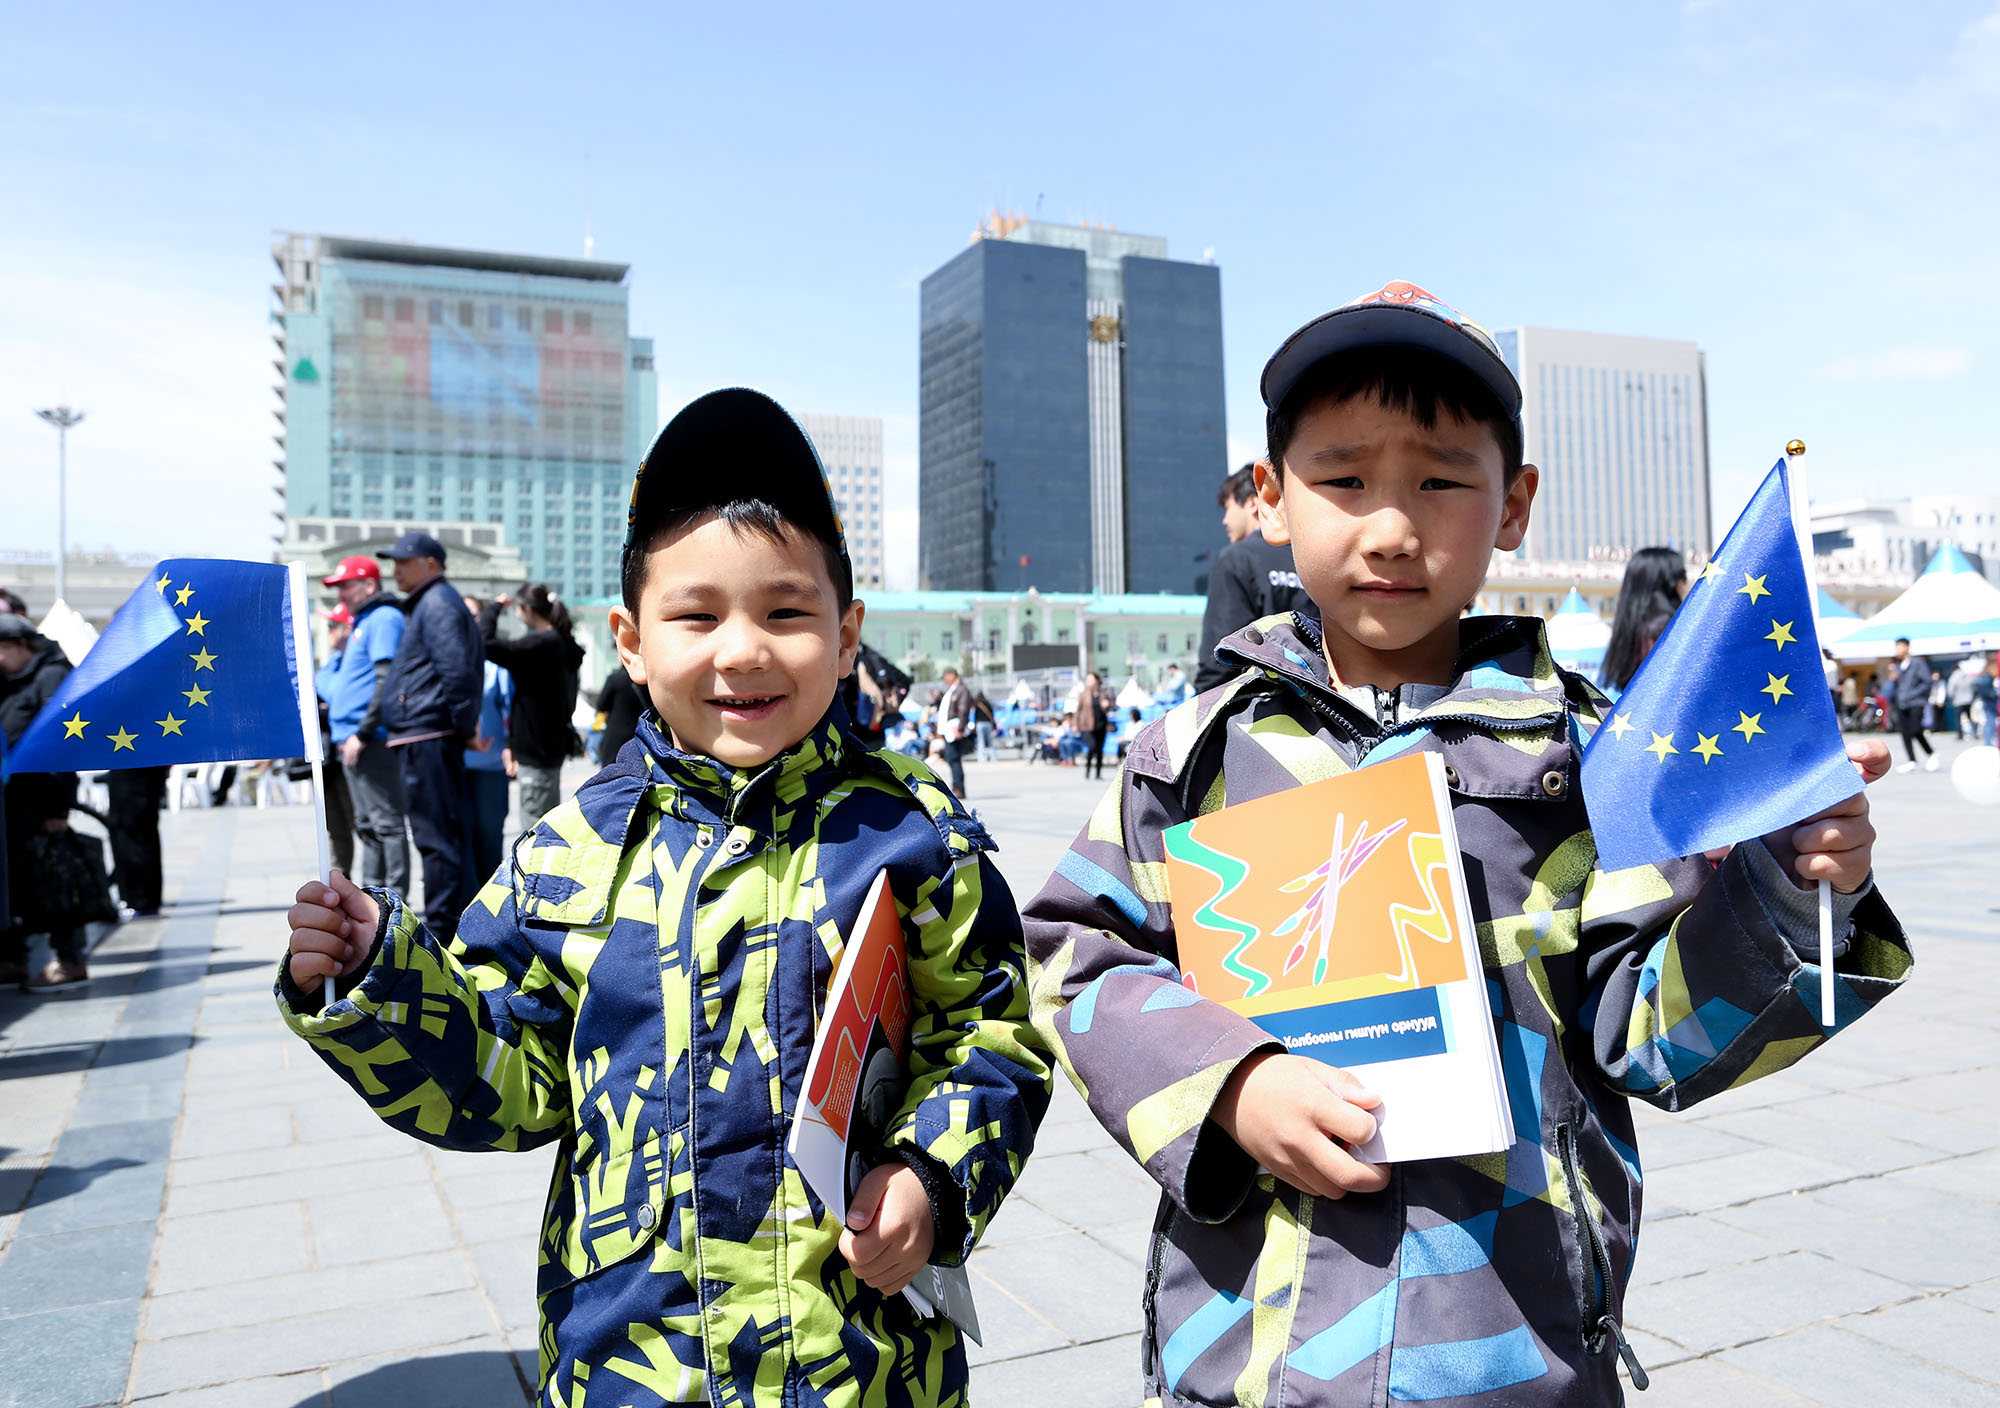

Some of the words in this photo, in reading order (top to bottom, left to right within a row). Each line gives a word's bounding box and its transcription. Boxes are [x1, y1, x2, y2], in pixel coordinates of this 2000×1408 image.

[1283, 1031, 1344, 1048] Холбооны
[1344, 1023, 1390, 1040] гишүүн
[1391, 1016, 1438, 1035] орнууд
